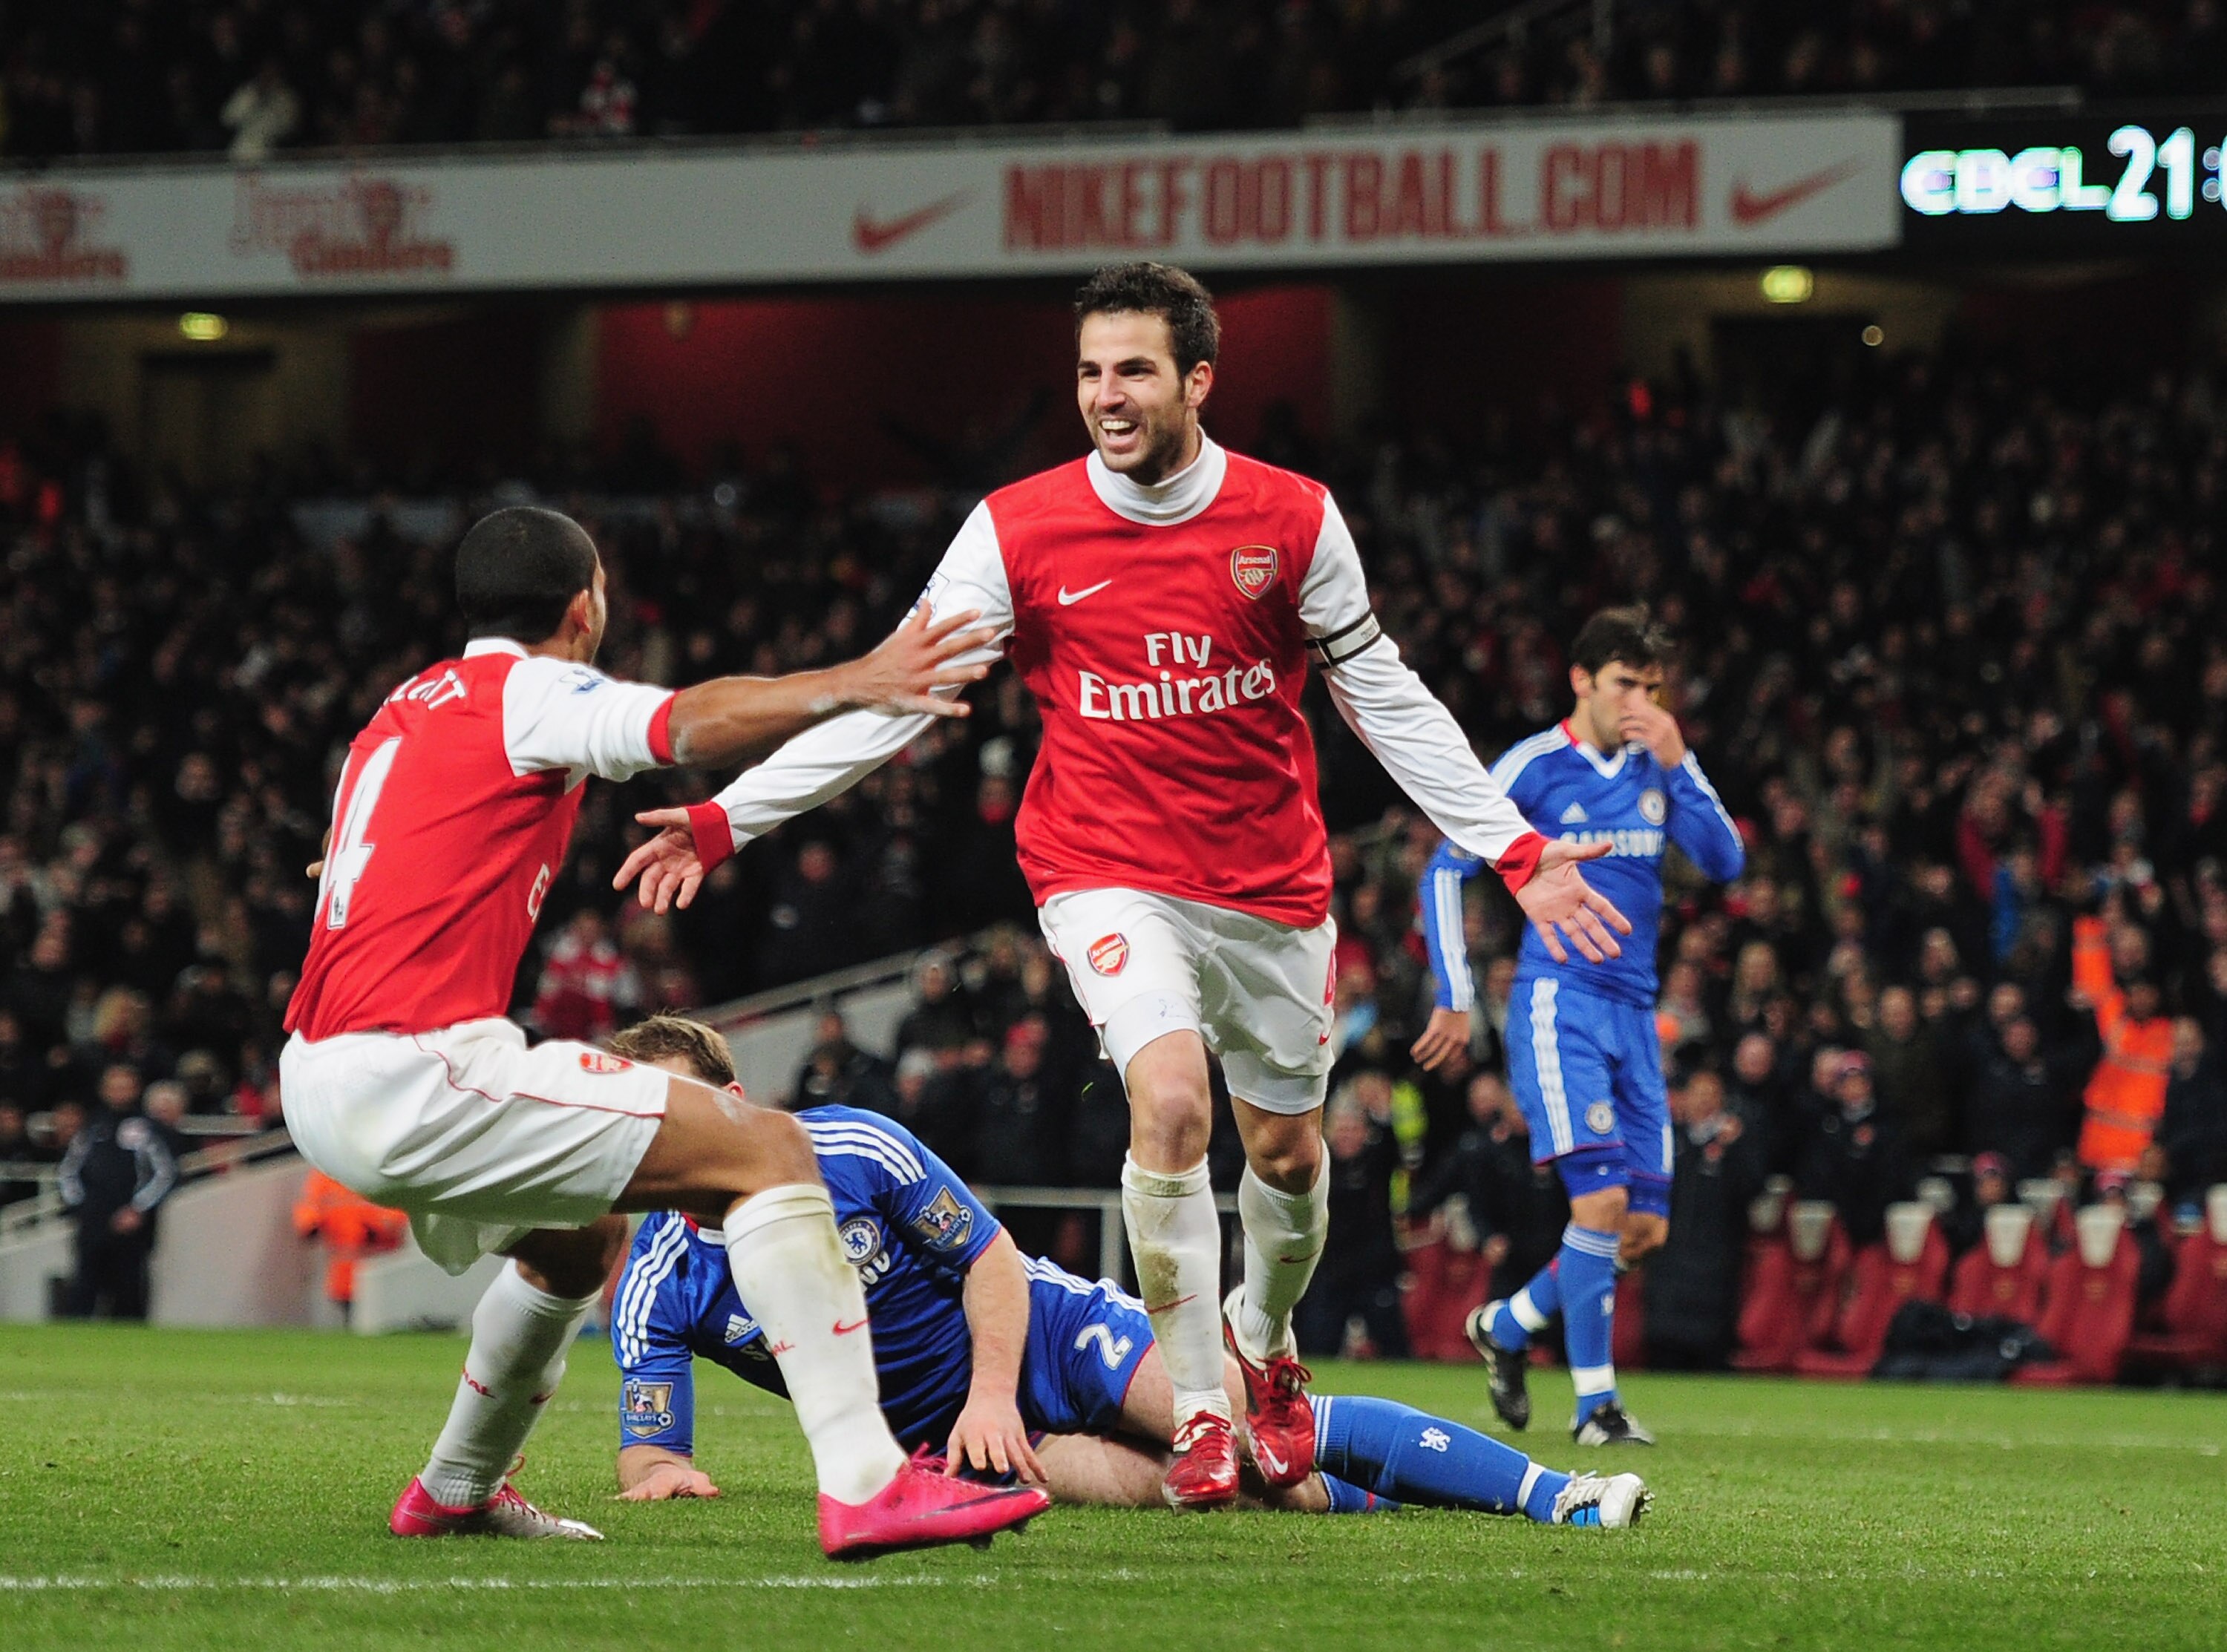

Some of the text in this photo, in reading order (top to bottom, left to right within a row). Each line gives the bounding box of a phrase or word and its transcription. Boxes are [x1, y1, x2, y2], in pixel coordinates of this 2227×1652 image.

[1001, 138, 1701, 255] NIKEFOOTBALL.COM
[2106, 125, 2227, 221] 21:
[1144, 632, 1211, 668] Fly
[1079, 658, 1276, 721] Emirates
[1073, 1322, 1133, 1371] 2
